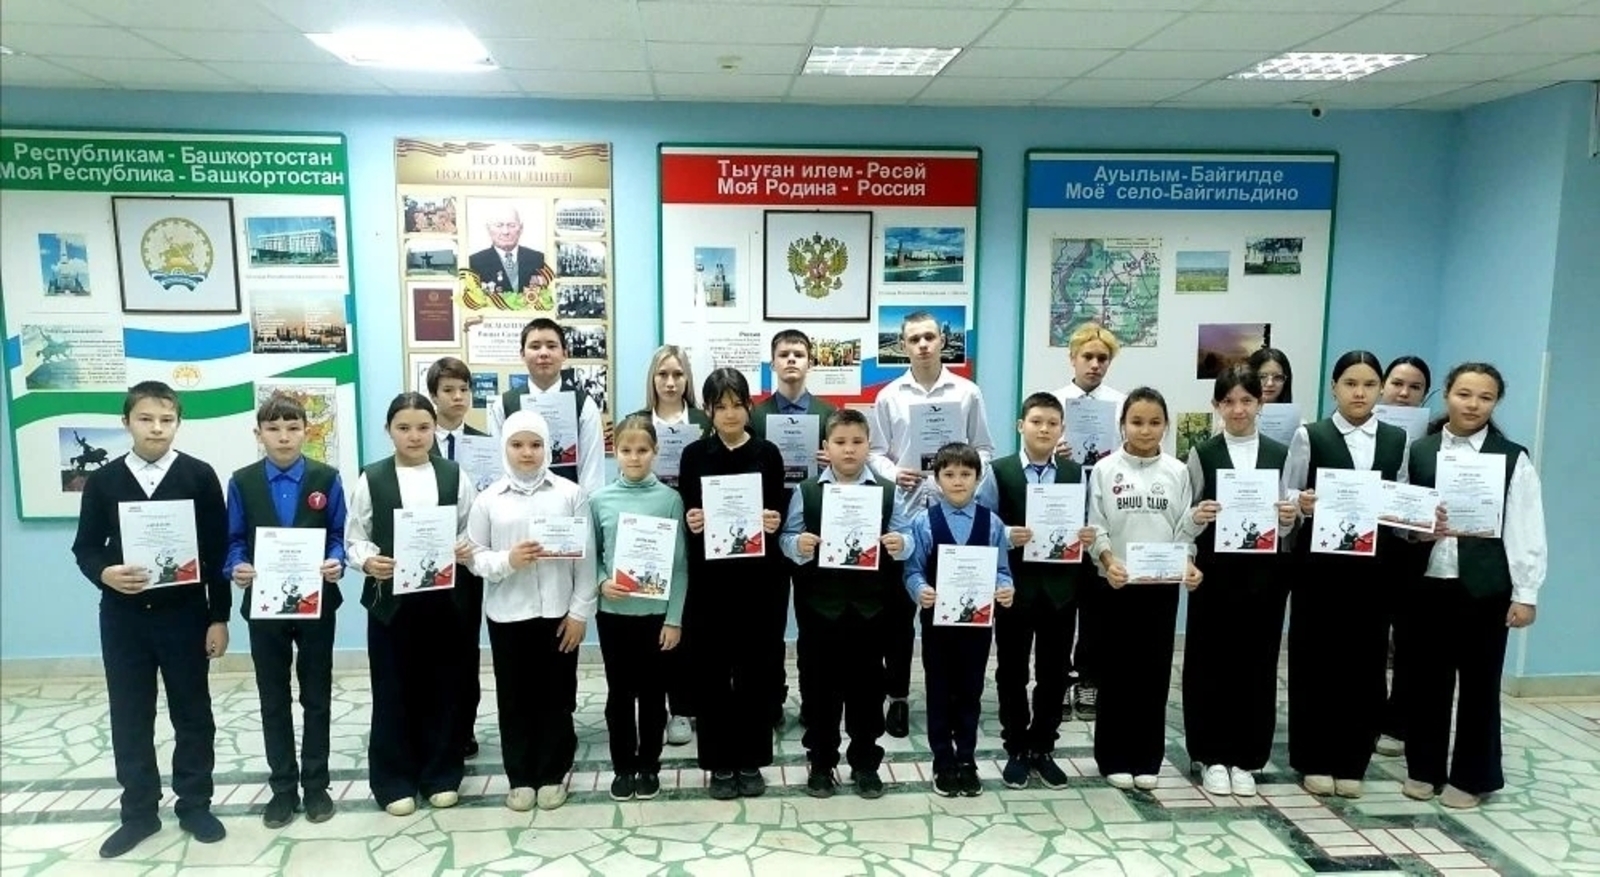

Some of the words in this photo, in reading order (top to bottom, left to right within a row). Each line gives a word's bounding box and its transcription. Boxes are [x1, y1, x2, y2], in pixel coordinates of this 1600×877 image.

[14, 142, 164, 165] Республикам
[181, 146, 333, 169] Башкортостан
[0, 161, 43, 180] Моя
[47, 162, 175, 185] Республика
[191, 165, 345, 188] Башкортостан
[718, 160, 794, 181] Тыуған
[718, 177, 757, 195] Моя
[766, 178, 837, 199] Родина
[857, 179, 926, 196] Россия
[1066, 182, 1105, 199] Моё
